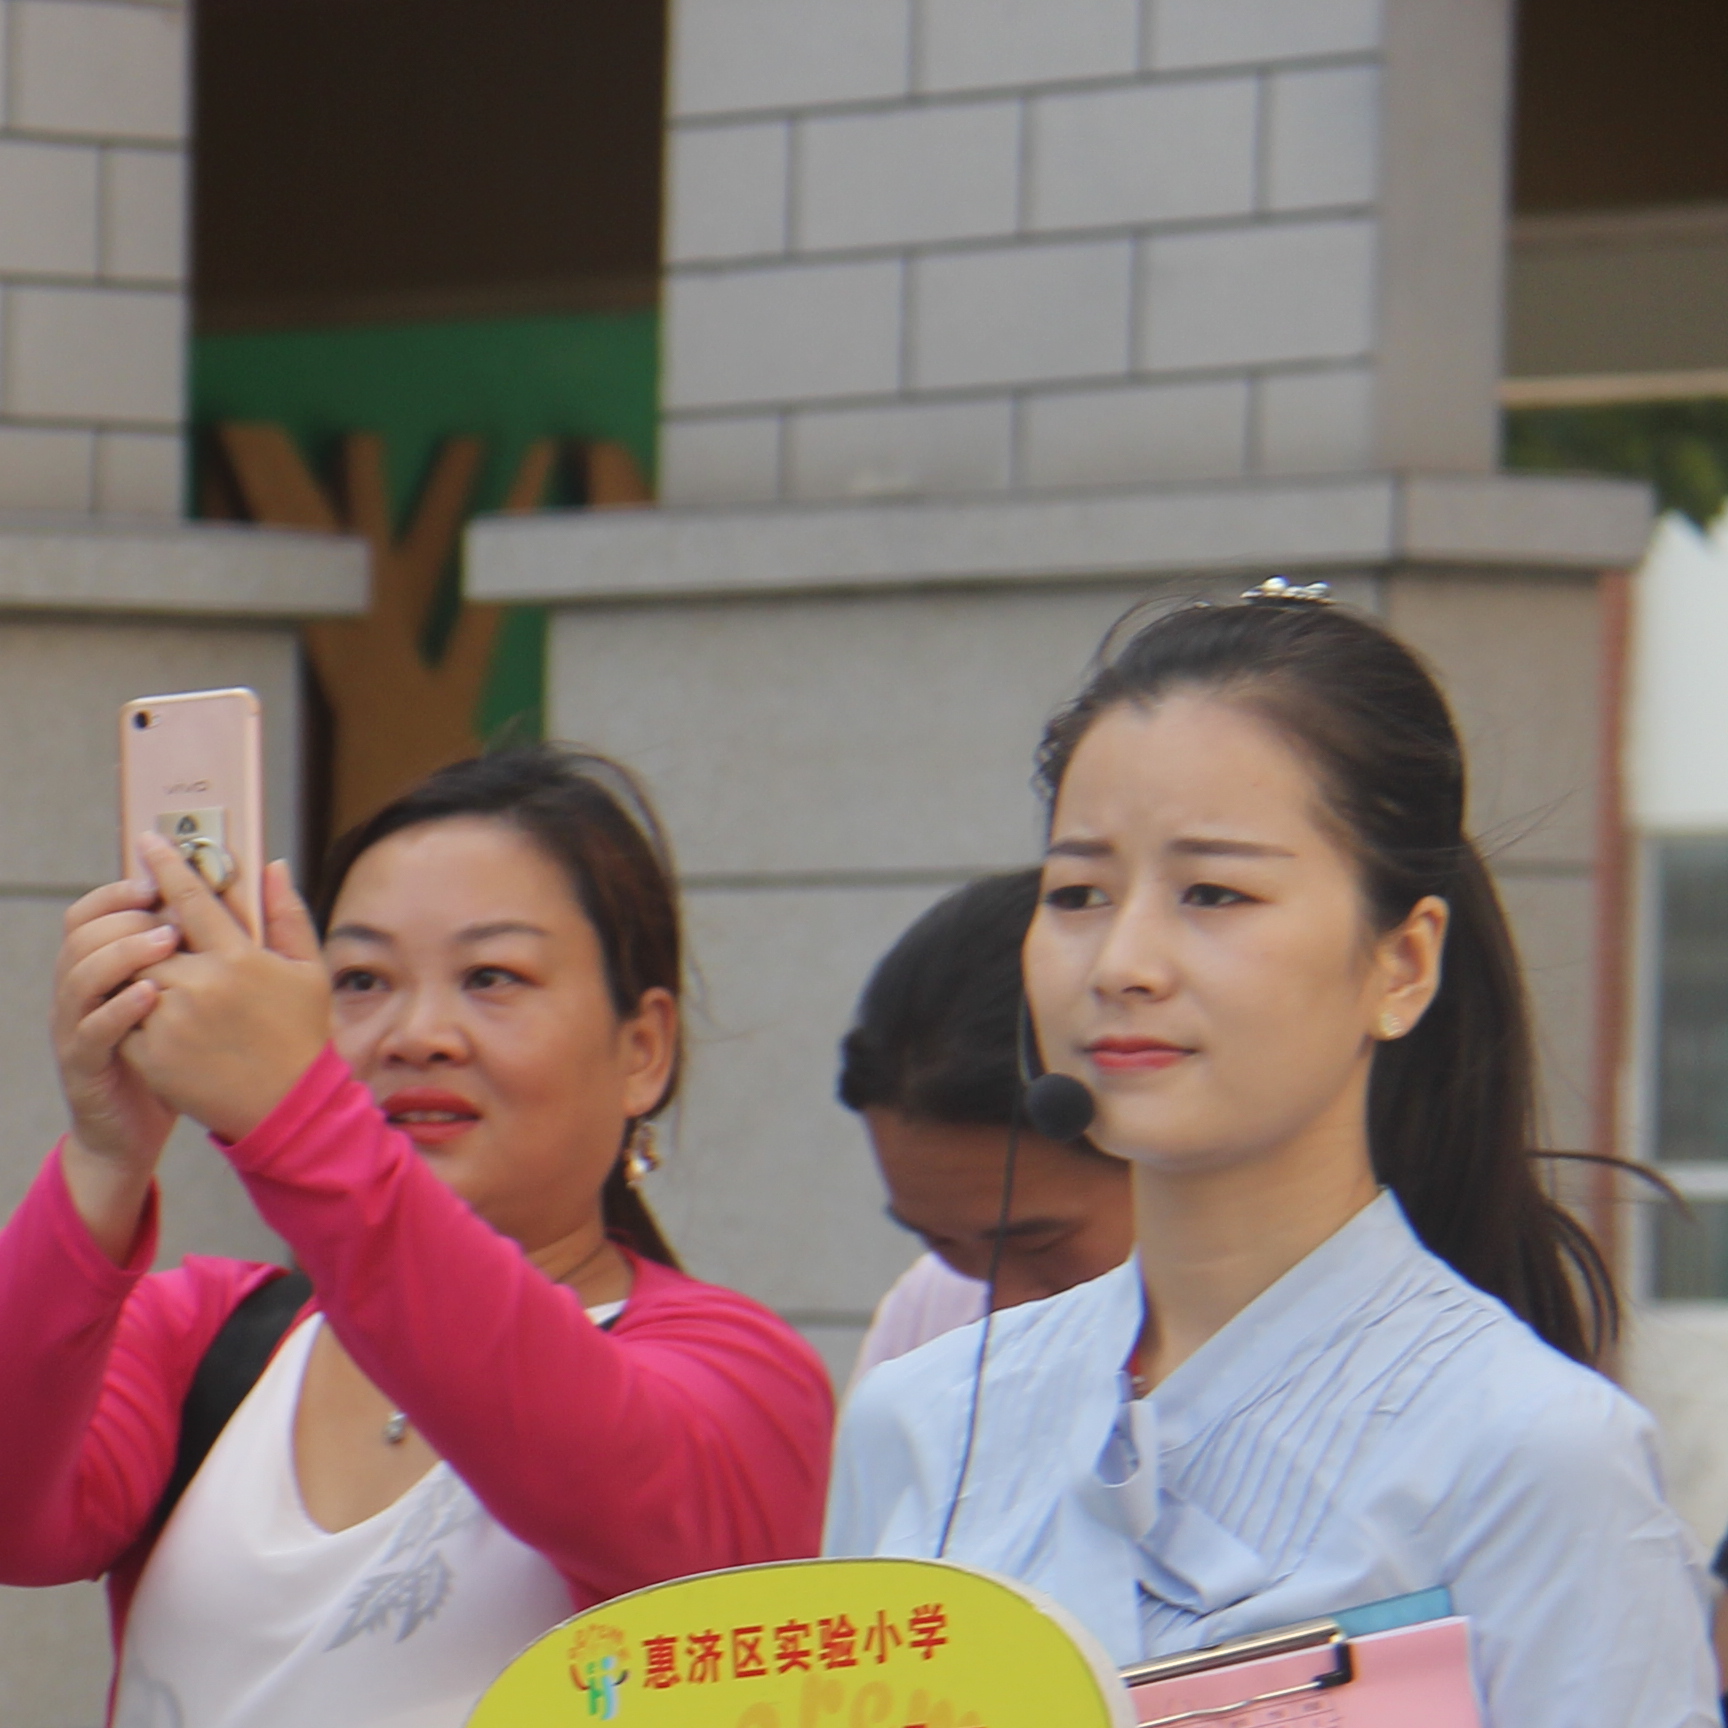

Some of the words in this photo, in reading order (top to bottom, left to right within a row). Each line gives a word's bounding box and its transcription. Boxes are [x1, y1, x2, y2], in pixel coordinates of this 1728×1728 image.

[641, 1602, 950, 1690] 惠济区实验小学
